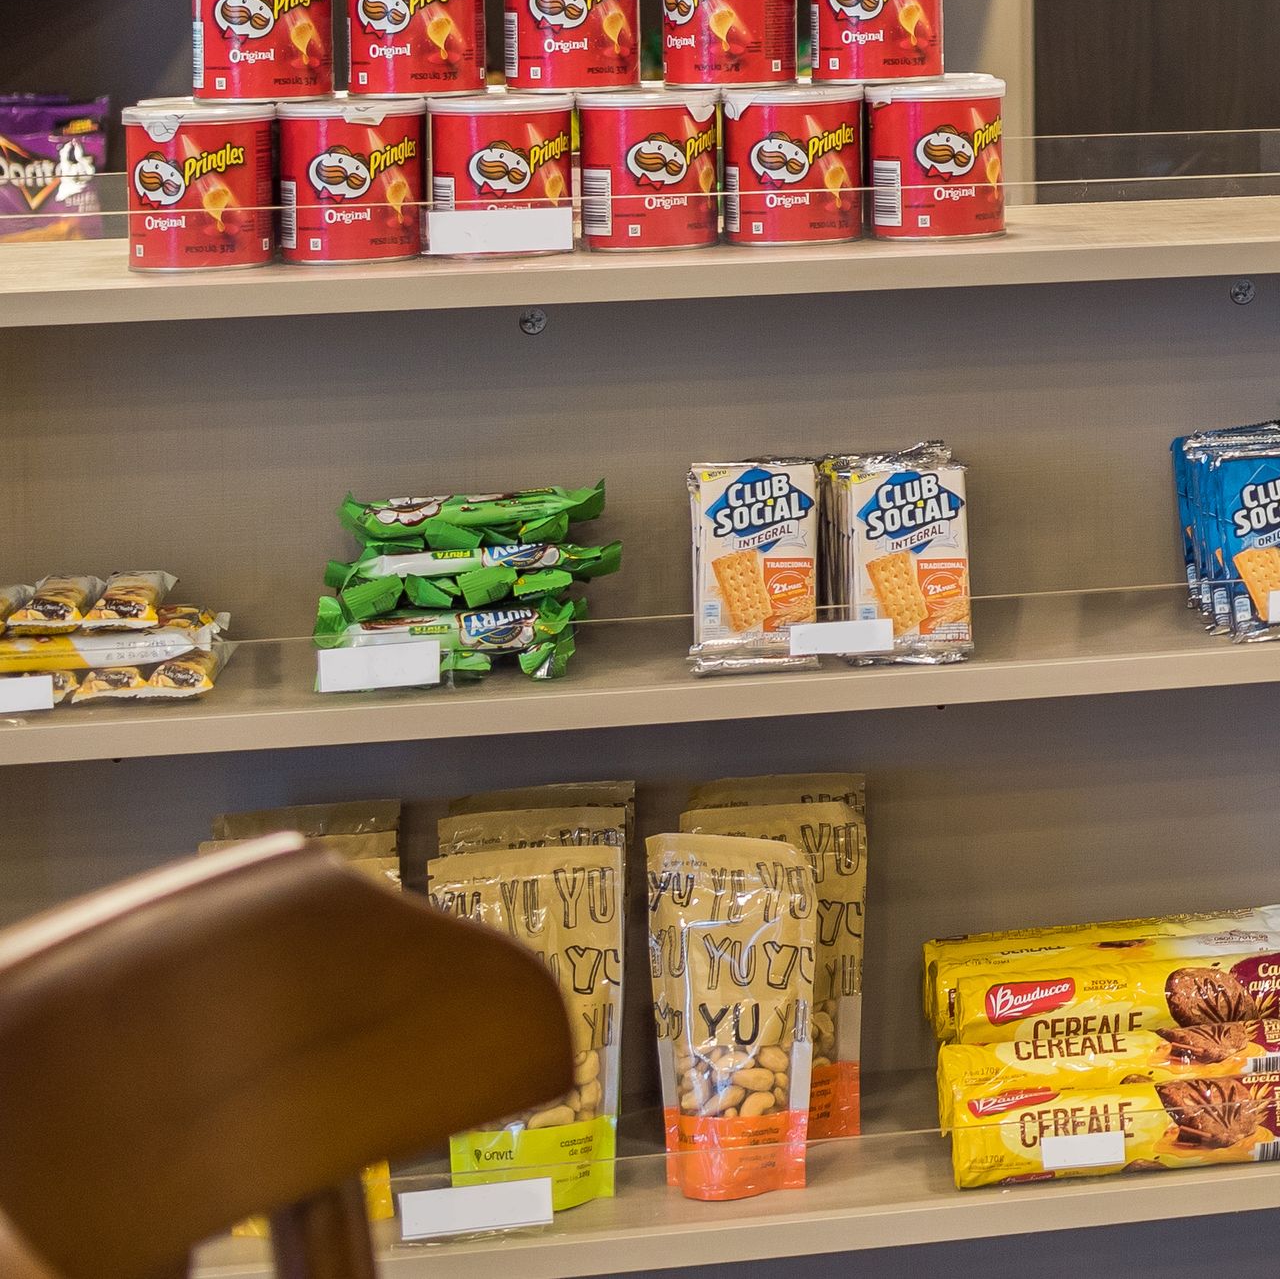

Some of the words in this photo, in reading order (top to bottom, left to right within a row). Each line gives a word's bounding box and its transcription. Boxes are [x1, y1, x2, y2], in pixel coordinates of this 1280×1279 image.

[543, 37, 589, 53] Original
[666, 33, 696, 50] Original
[840, 28, 884, 45] Original
[228, 47, 275, 64] Original
[369, 43, 412, 60] Original
[808, 122, 855, 165] Pringles
[184, 143, 245, 188] Pringles
[369, 136, 416, 179] Pringles
[643, 193, 689, 210] Original
[765, 192, 811, 208] Original
[933, 185, 976, 201] Original
[144, 214, 187, 232] Original
[324, 207, 371, 224] Original
[727, 474, 790, 507] CLUB
[877, 475, 940, 509] CLUB
[738, 526, 794, 549] INTEGRAL
[890, 525, 945, 551] INTEGRAL
[766, 560, 813, 570] TRADICIONAL
[920, 561, 964, 570] TRADICIONAL
[470, 607, 532, 635] NUTRY
[801, 821, 860, 883] YU
[553, 866, 616, 930] YU
[756, 861, 813, 922] YU
[702, 932, 757, 991] YU
[989, 982, 1071, 1019] Bauducco
[698, 1002, 760, 1046] YU
[1033, 1011, 1144, 1040] CEREALE
[1014, 1033, 1128, 1061] CEREALE
[1019, 1102, 1135, 1148] CEREALE
[560, 1134, 594, 1148] castanha
[484, 1149, 514, 1161] onvit
